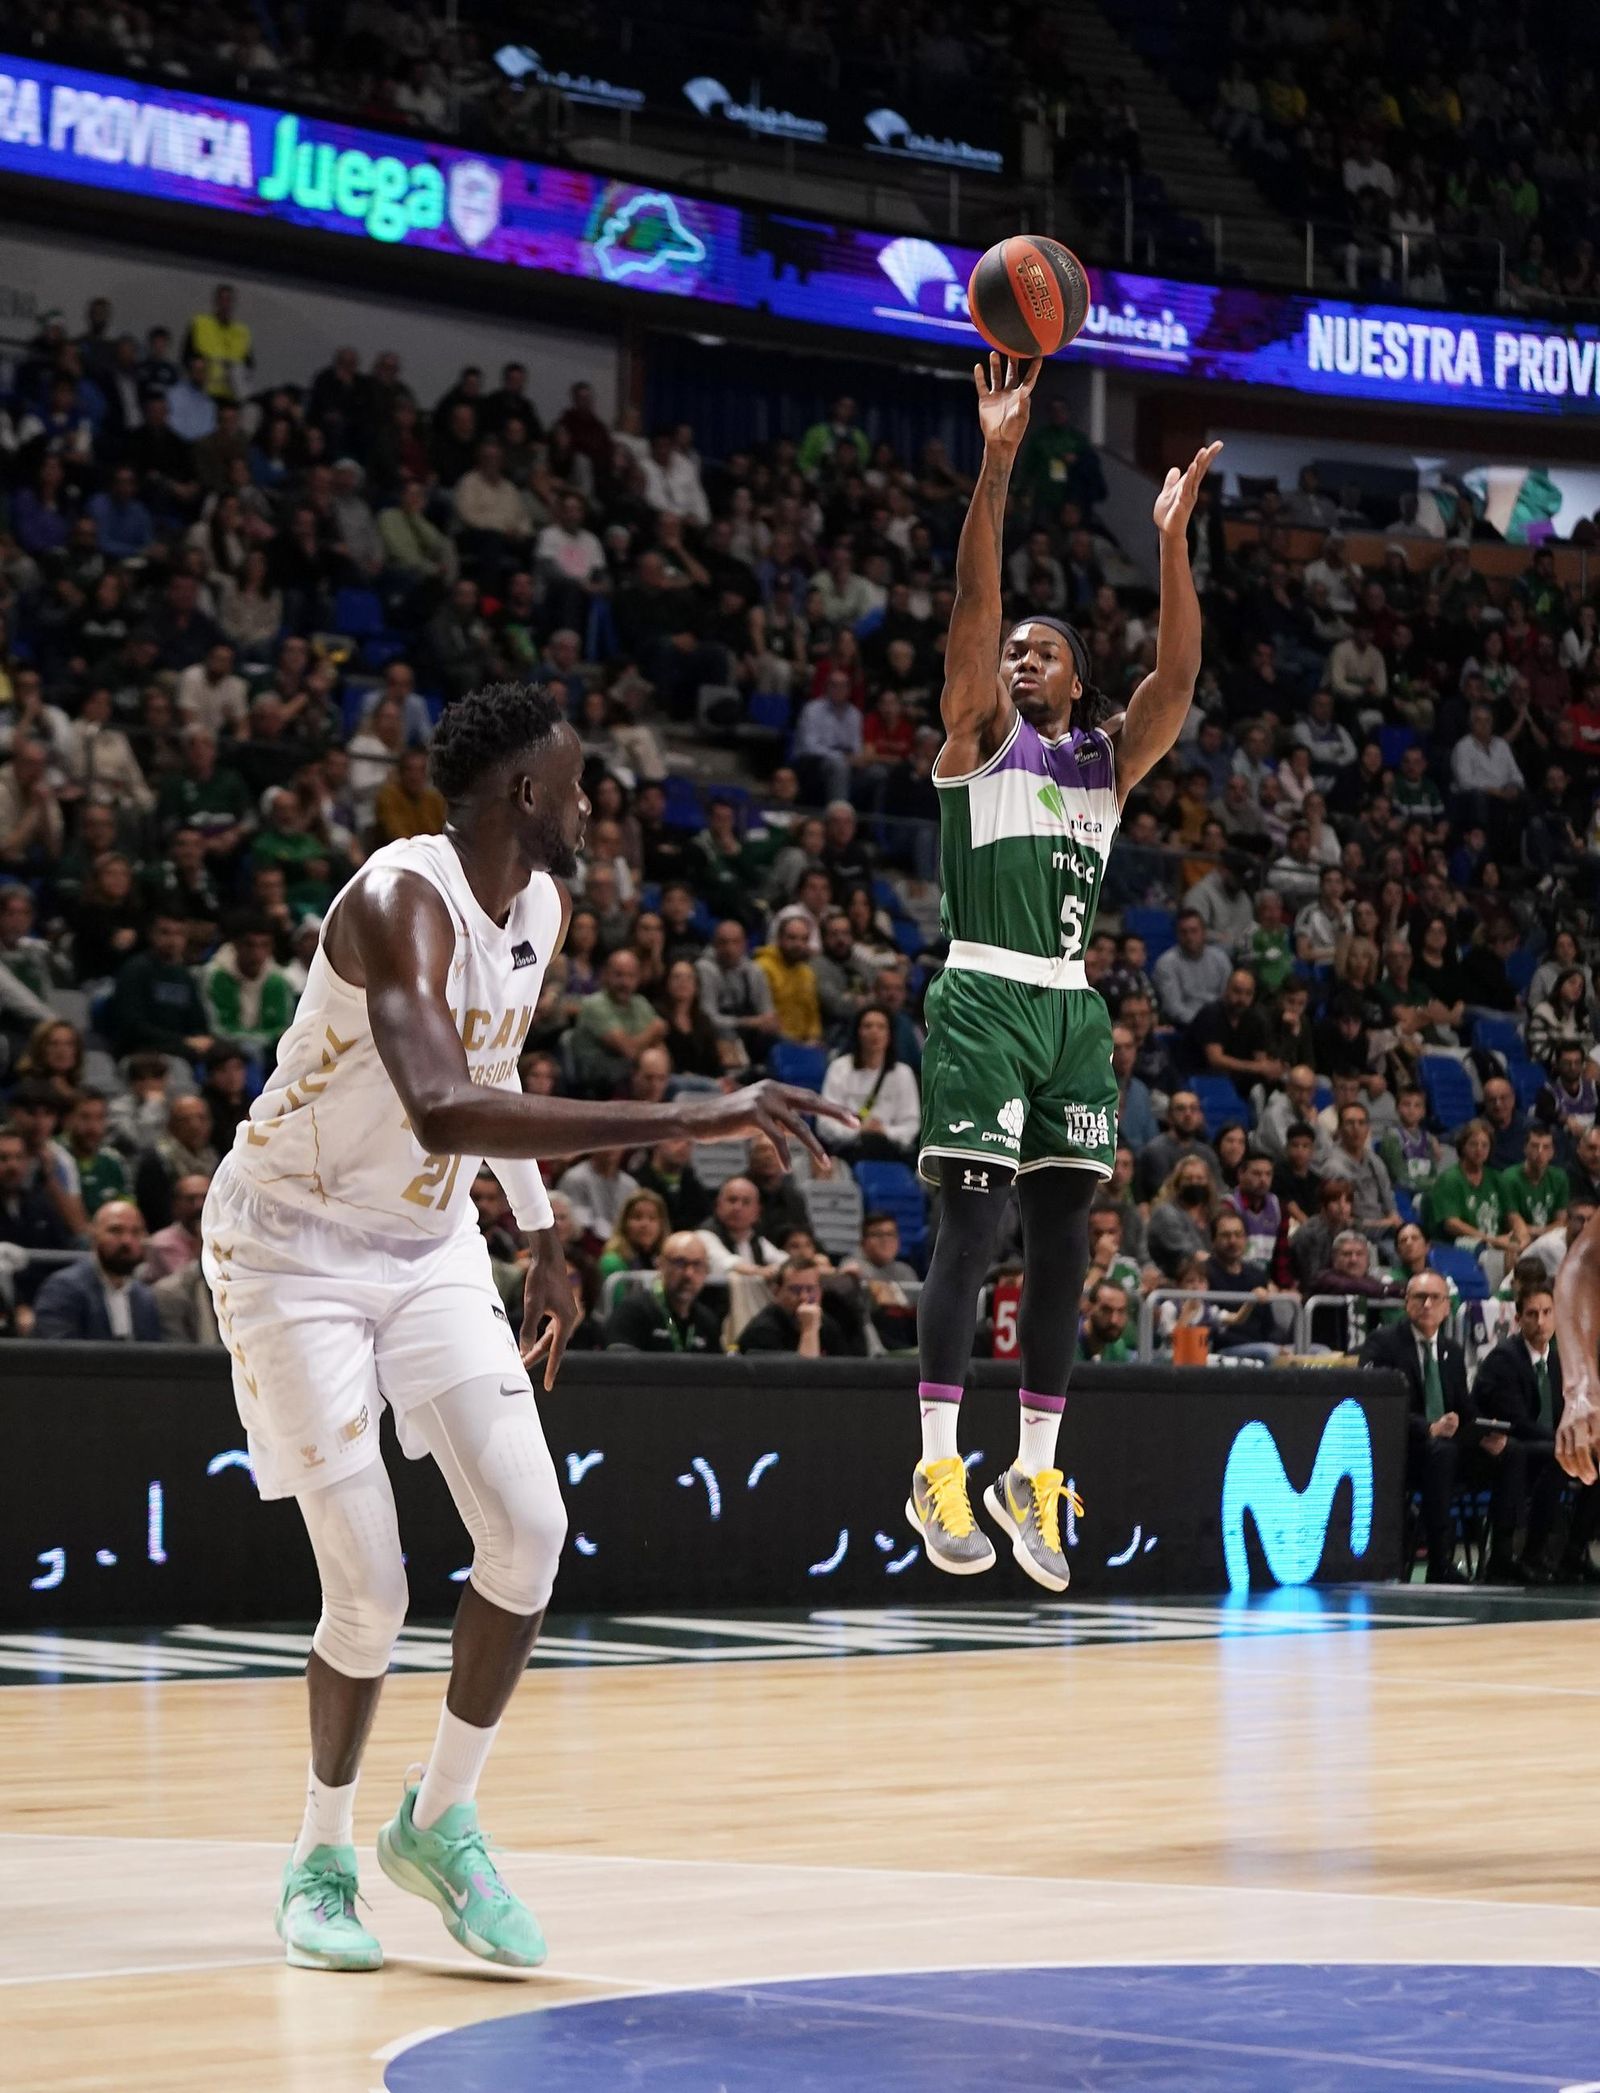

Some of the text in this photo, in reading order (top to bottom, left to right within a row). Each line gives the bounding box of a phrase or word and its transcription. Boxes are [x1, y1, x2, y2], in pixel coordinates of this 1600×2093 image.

[49, 84, 253, 189] PROVINCIA
[257, 112, 446, 242] Juega
[1022, 254, 1058, 321] LEGACY
[1085, 303, 1189, 350] Unicaja
[1308, 313, 1483, 387] NUESTRA
[1060, 894, 1085, 949] 5
[1064, 1102, 1087, 1113] sabor
[400, 1152, 462, 1211] 21
